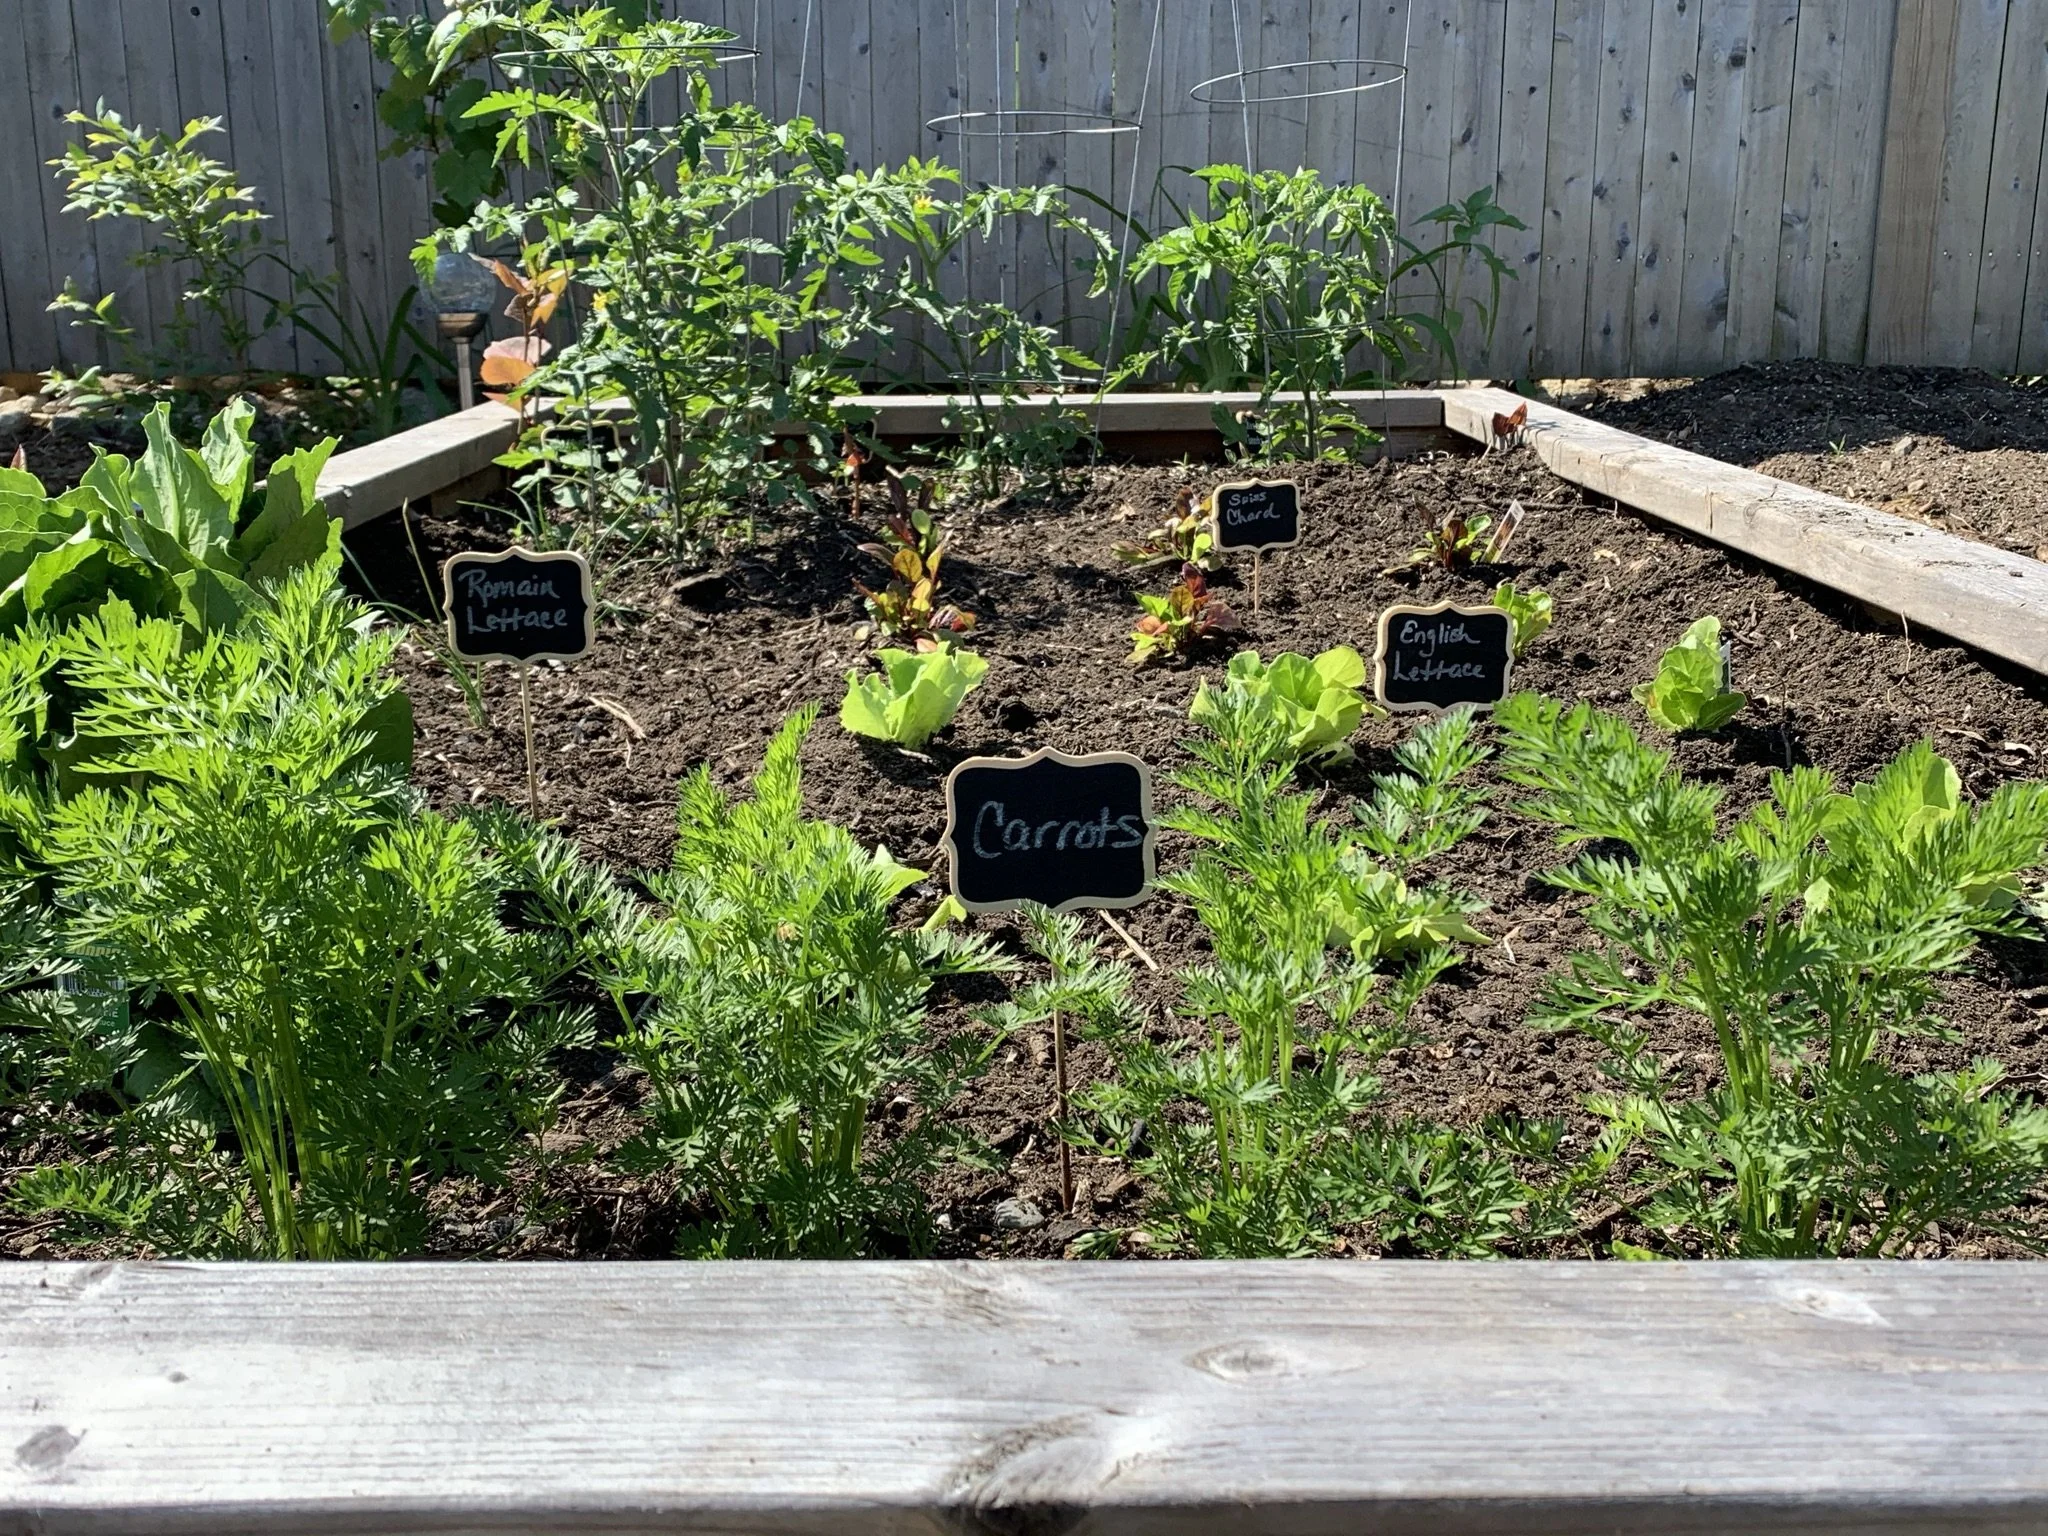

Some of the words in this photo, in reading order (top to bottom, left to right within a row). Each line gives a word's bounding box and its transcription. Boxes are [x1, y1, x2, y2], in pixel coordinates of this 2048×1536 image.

[1226, 502, 1281, 526] Chard
[1400, 619, 1481, 657] English
[973, 801, 1143, 859] Carrots
